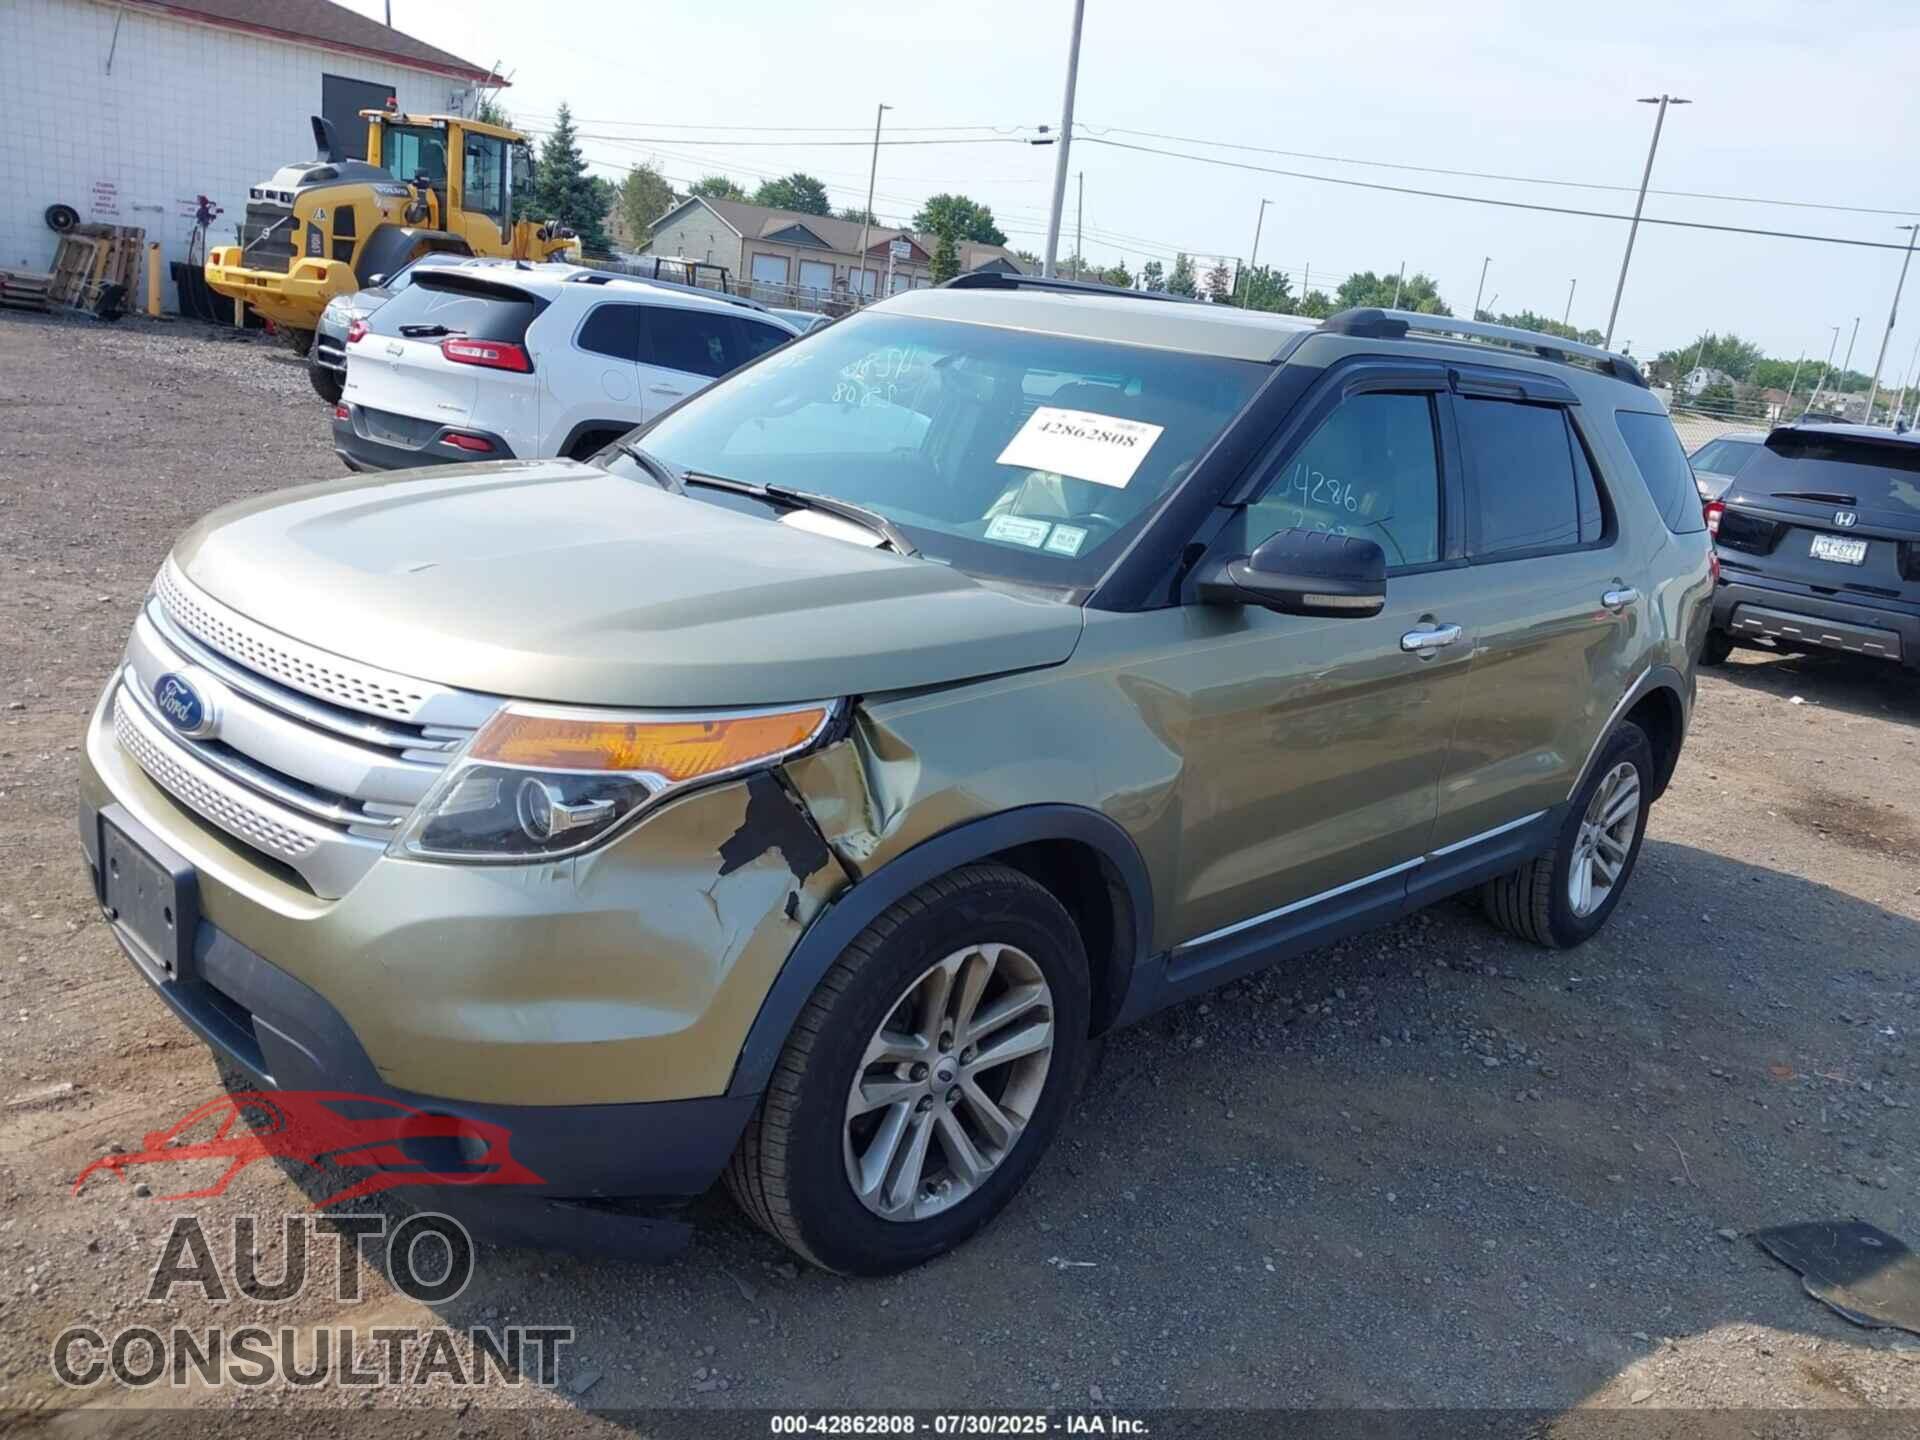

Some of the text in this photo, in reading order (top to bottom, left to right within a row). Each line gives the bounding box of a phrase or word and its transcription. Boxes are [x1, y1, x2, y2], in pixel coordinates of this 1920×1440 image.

[1037, 420, 1139, 448] 42862808
[1293, 463, 1358, 512] 4286
[159, 679, 193, 722] Ford
